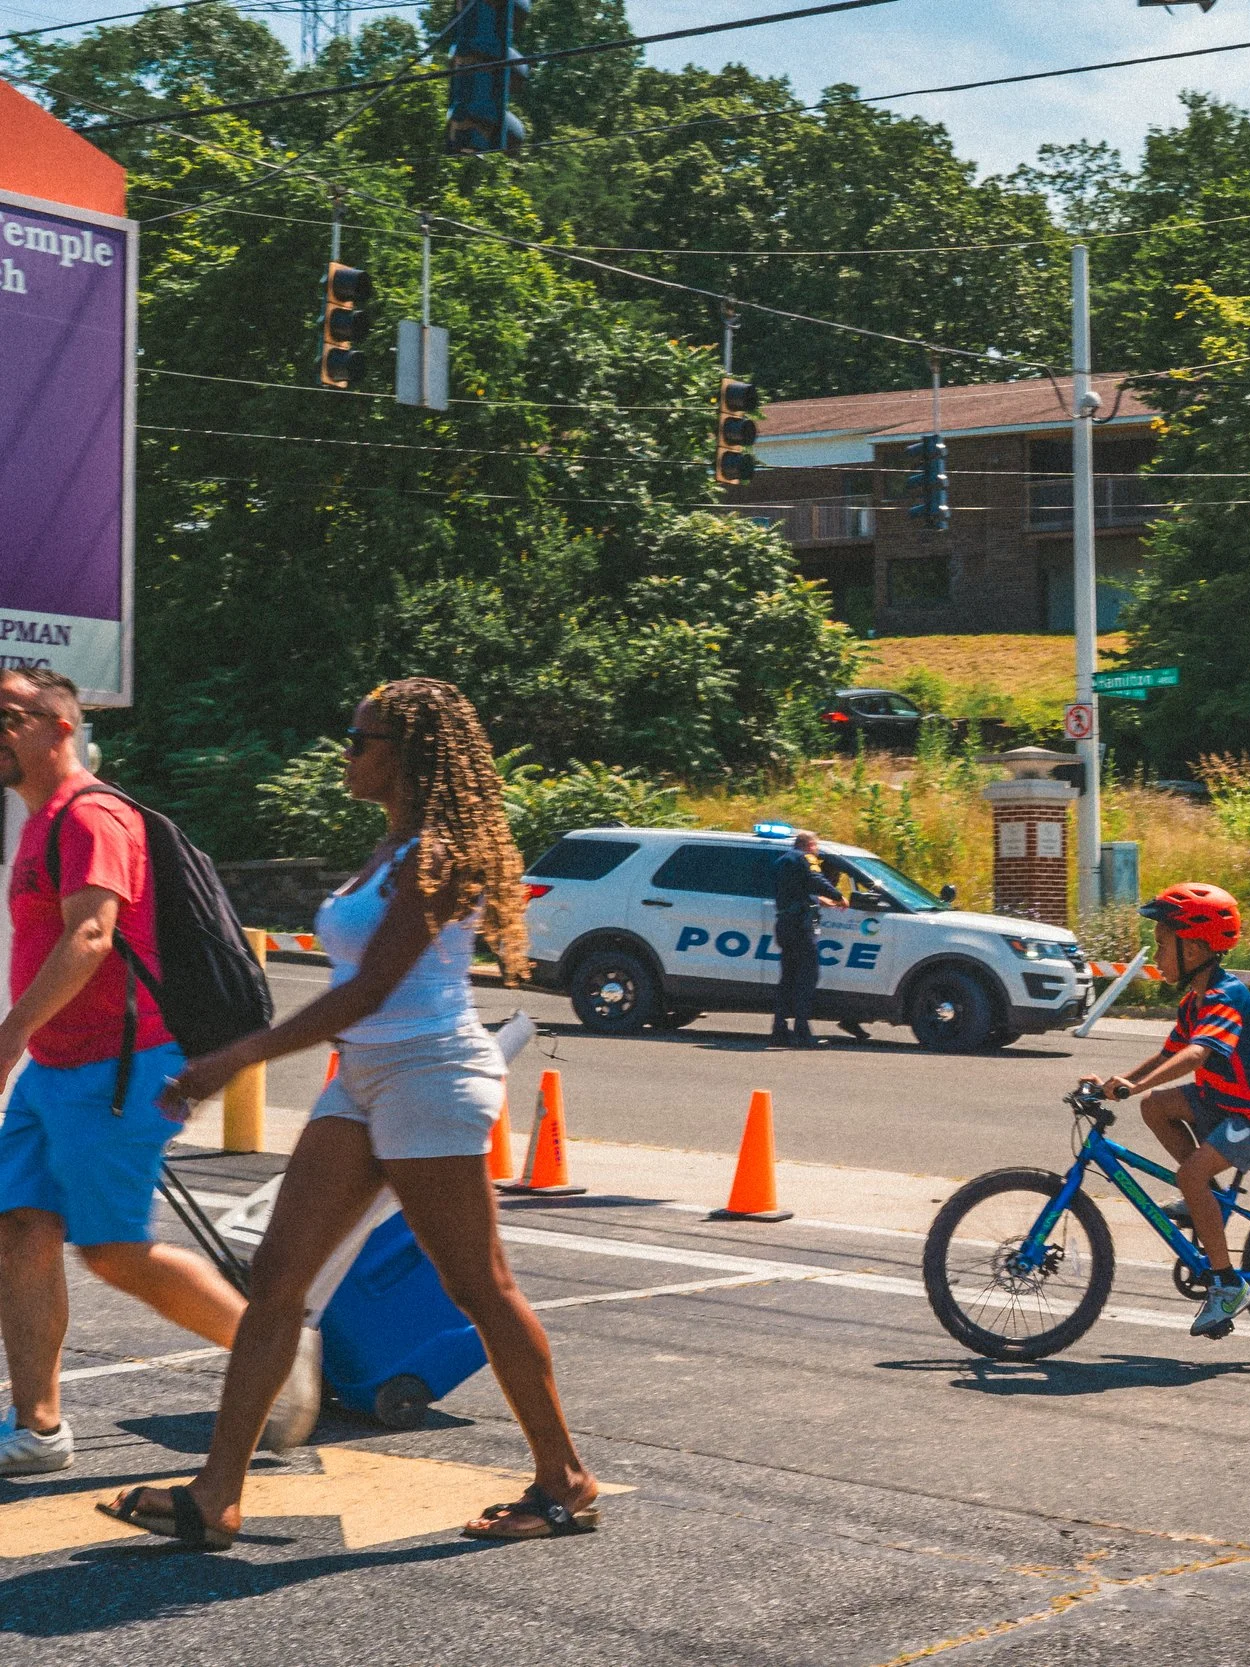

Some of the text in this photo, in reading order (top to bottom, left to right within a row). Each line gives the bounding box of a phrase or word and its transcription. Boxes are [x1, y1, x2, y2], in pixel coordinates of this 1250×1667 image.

[0, 212, 114, 267] emple
[0, 258, 27, 294] h
[676, 926, 882, 970] POLCE
